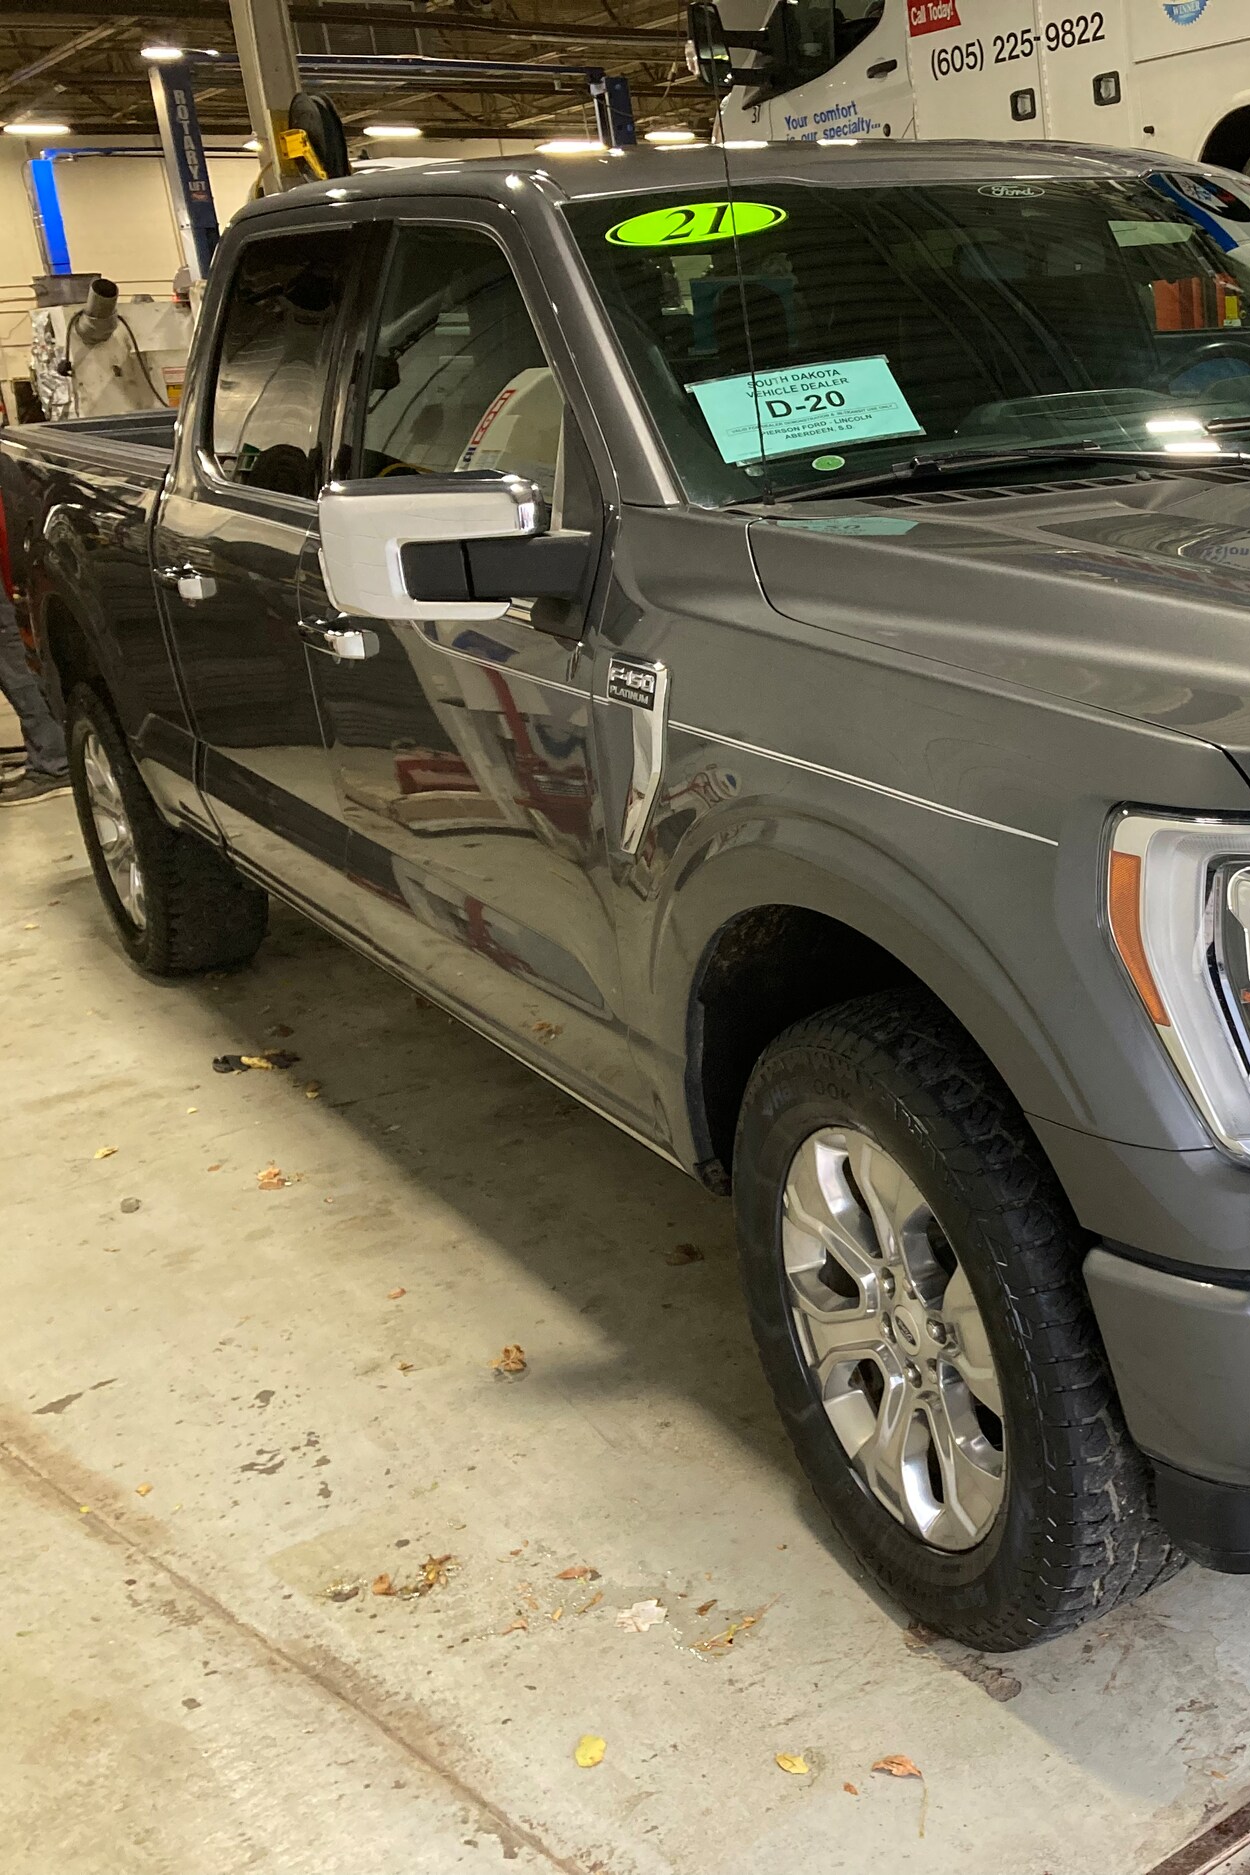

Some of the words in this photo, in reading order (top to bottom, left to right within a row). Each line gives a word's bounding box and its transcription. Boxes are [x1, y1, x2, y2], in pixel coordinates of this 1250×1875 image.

[911, 3, 926, 26] Call
[928, 0, 954, 21] Today!
[931, 39, 985, 81] (605)
[993, 11, 1106, 64] 225-9822
[784, 114, 808, 131] Your
[814, 100, 857, 125] comfort
[991, 185, 1035, 196] Ford
[662, 203, 730, 241] 21
[746, 385, 799, 398] VEHICLE
[800, 377, 850, 392] DEALER
[747, 376, 789, 389] SOUTH
[791, 369, 841, 382] DAKOTA
[765, 390, 846, 418] D-20
[802, 421, 827, 430] FORD
[834, 414, 872, 425] LINCOLN
[610, 667, 655, 693] F-150
[609, 685, 649, 705] PLATINUM
